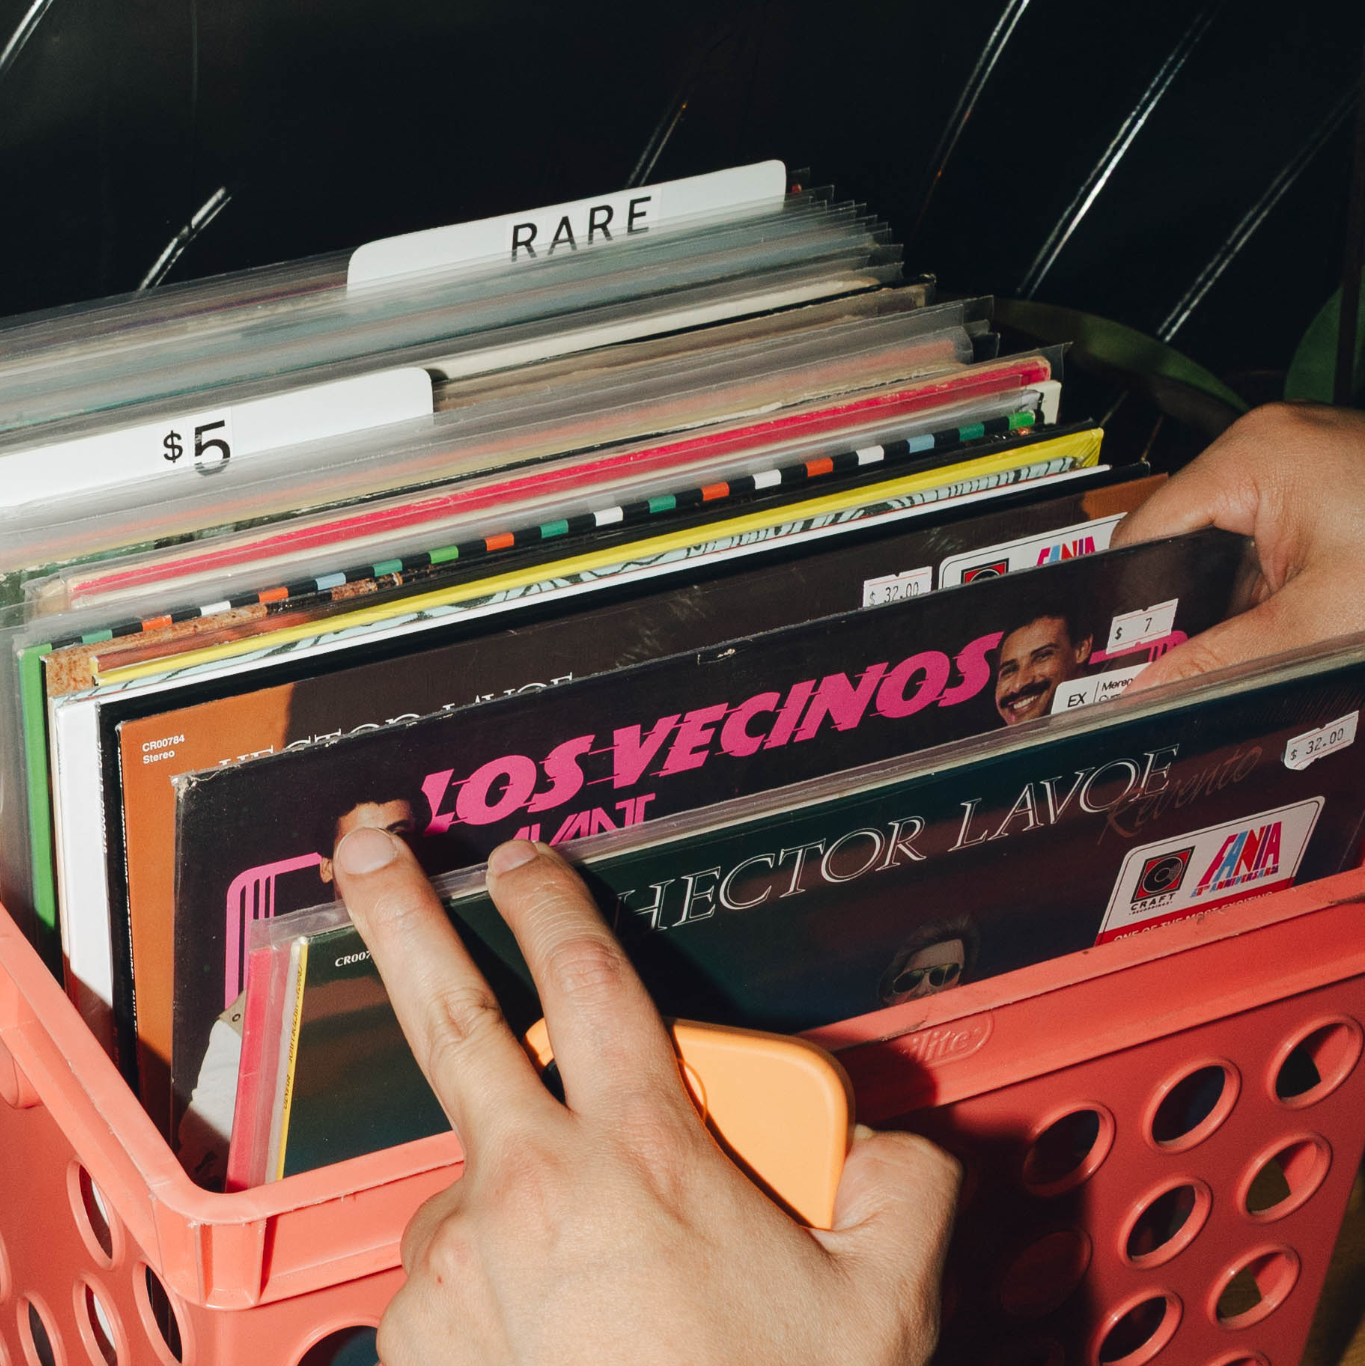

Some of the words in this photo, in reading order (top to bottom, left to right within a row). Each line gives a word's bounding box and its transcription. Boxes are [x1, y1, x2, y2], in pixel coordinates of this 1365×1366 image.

[510, 195, 652, 263] RARE
[162, 419, 232, 477] $5
[883, 581, 919, 603] 32.00
[1144, 617, 1153, 633] 7
[1067, 691, 1088, 708] EX
[142, 734, 185, 752] CR00784
[422, 733, 596, 834] LOS
[592, 631, 1005, 788] VECINOS
[1306, 728, 1344, 755] 32.00
[143, 750, 175, 764] Stereo
[617, 815, 926, 933] HECTOR
[948, 743, 1180, 853] LAVOE
[1197, 821, 1283, 888] FANIA
[1130, 892, 1176, 912] CRAFT
